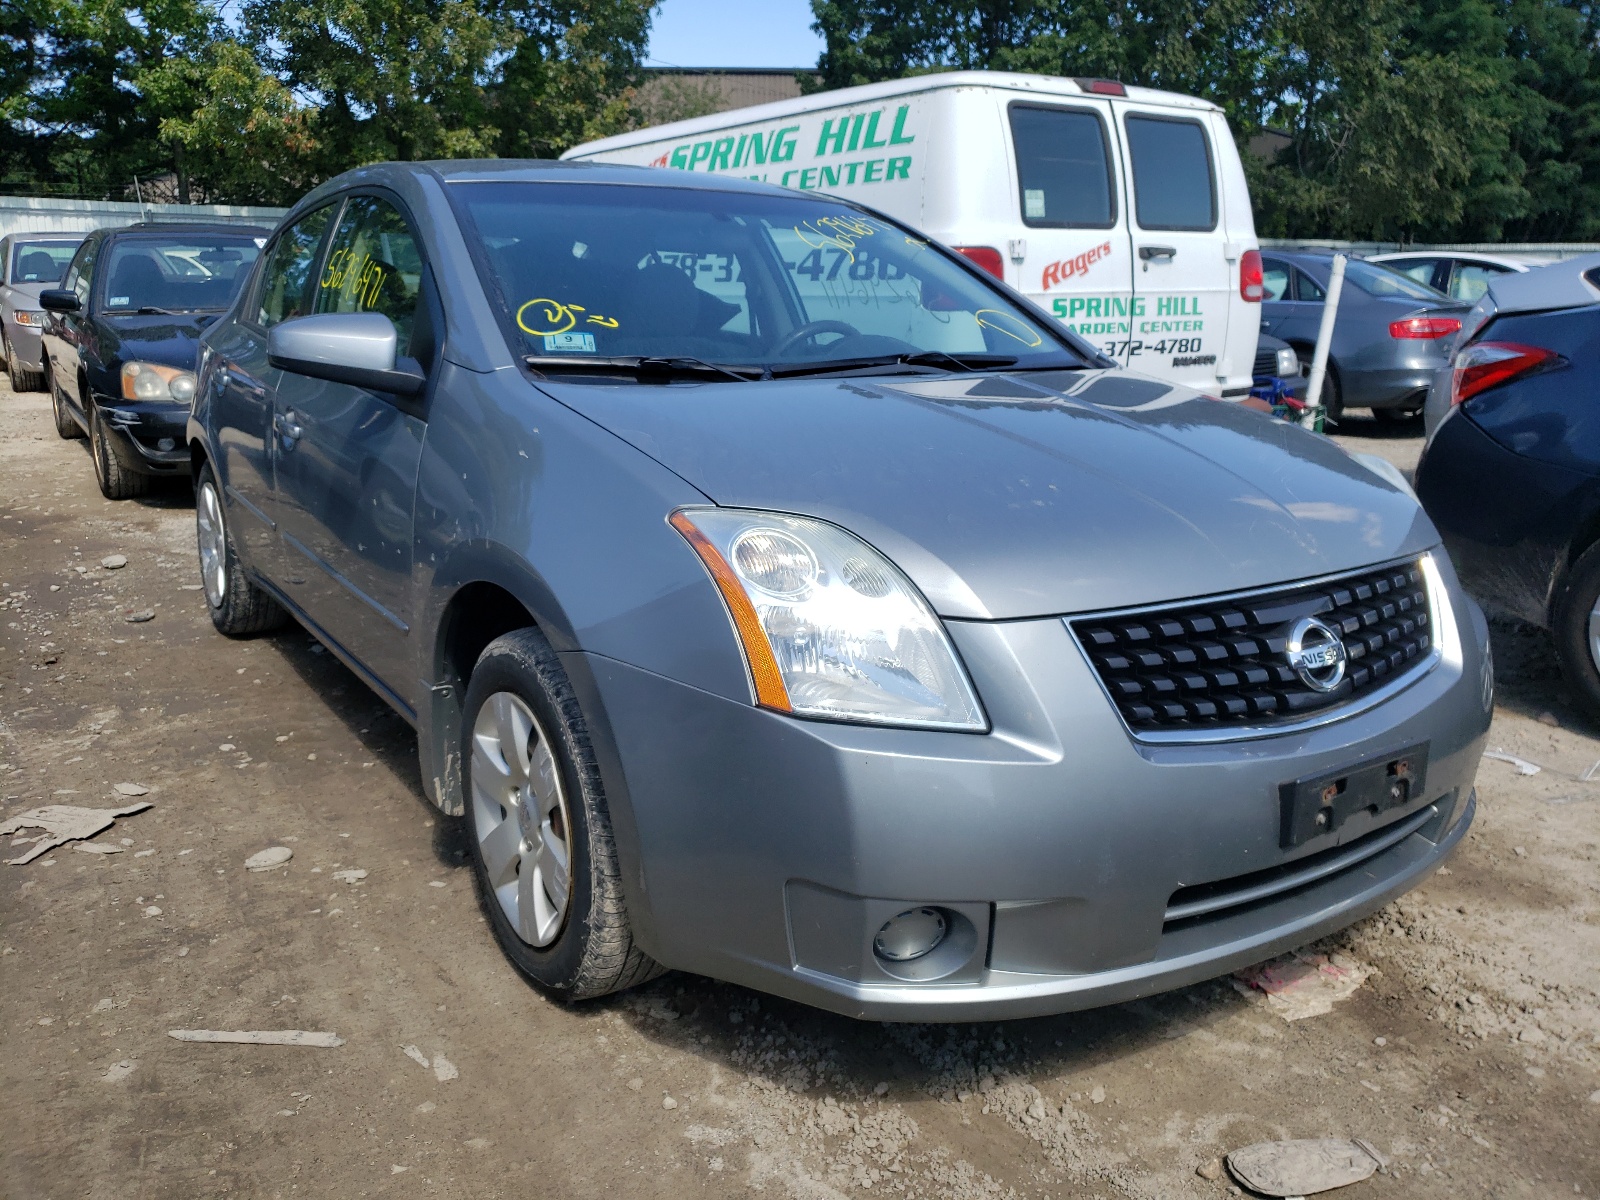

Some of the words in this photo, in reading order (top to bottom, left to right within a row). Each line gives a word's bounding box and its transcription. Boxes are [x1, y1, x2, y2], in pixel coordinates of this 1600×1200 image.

[669, 124, 800, 171] SPRING
[814, 105, 916, 157] HILL
[781, 155, 913, 190] CENTER
[1041, 240, 1112, 292] Rogers
[1052, 297, 1146, 319] SPRING
[1156, 296, 1204, 317] HILL
[1068, 322, 1130, 336] ARDEN
[1139, 320, 1204, 334] CENTER
[1098, 337, 1202, 357] -372-4780
